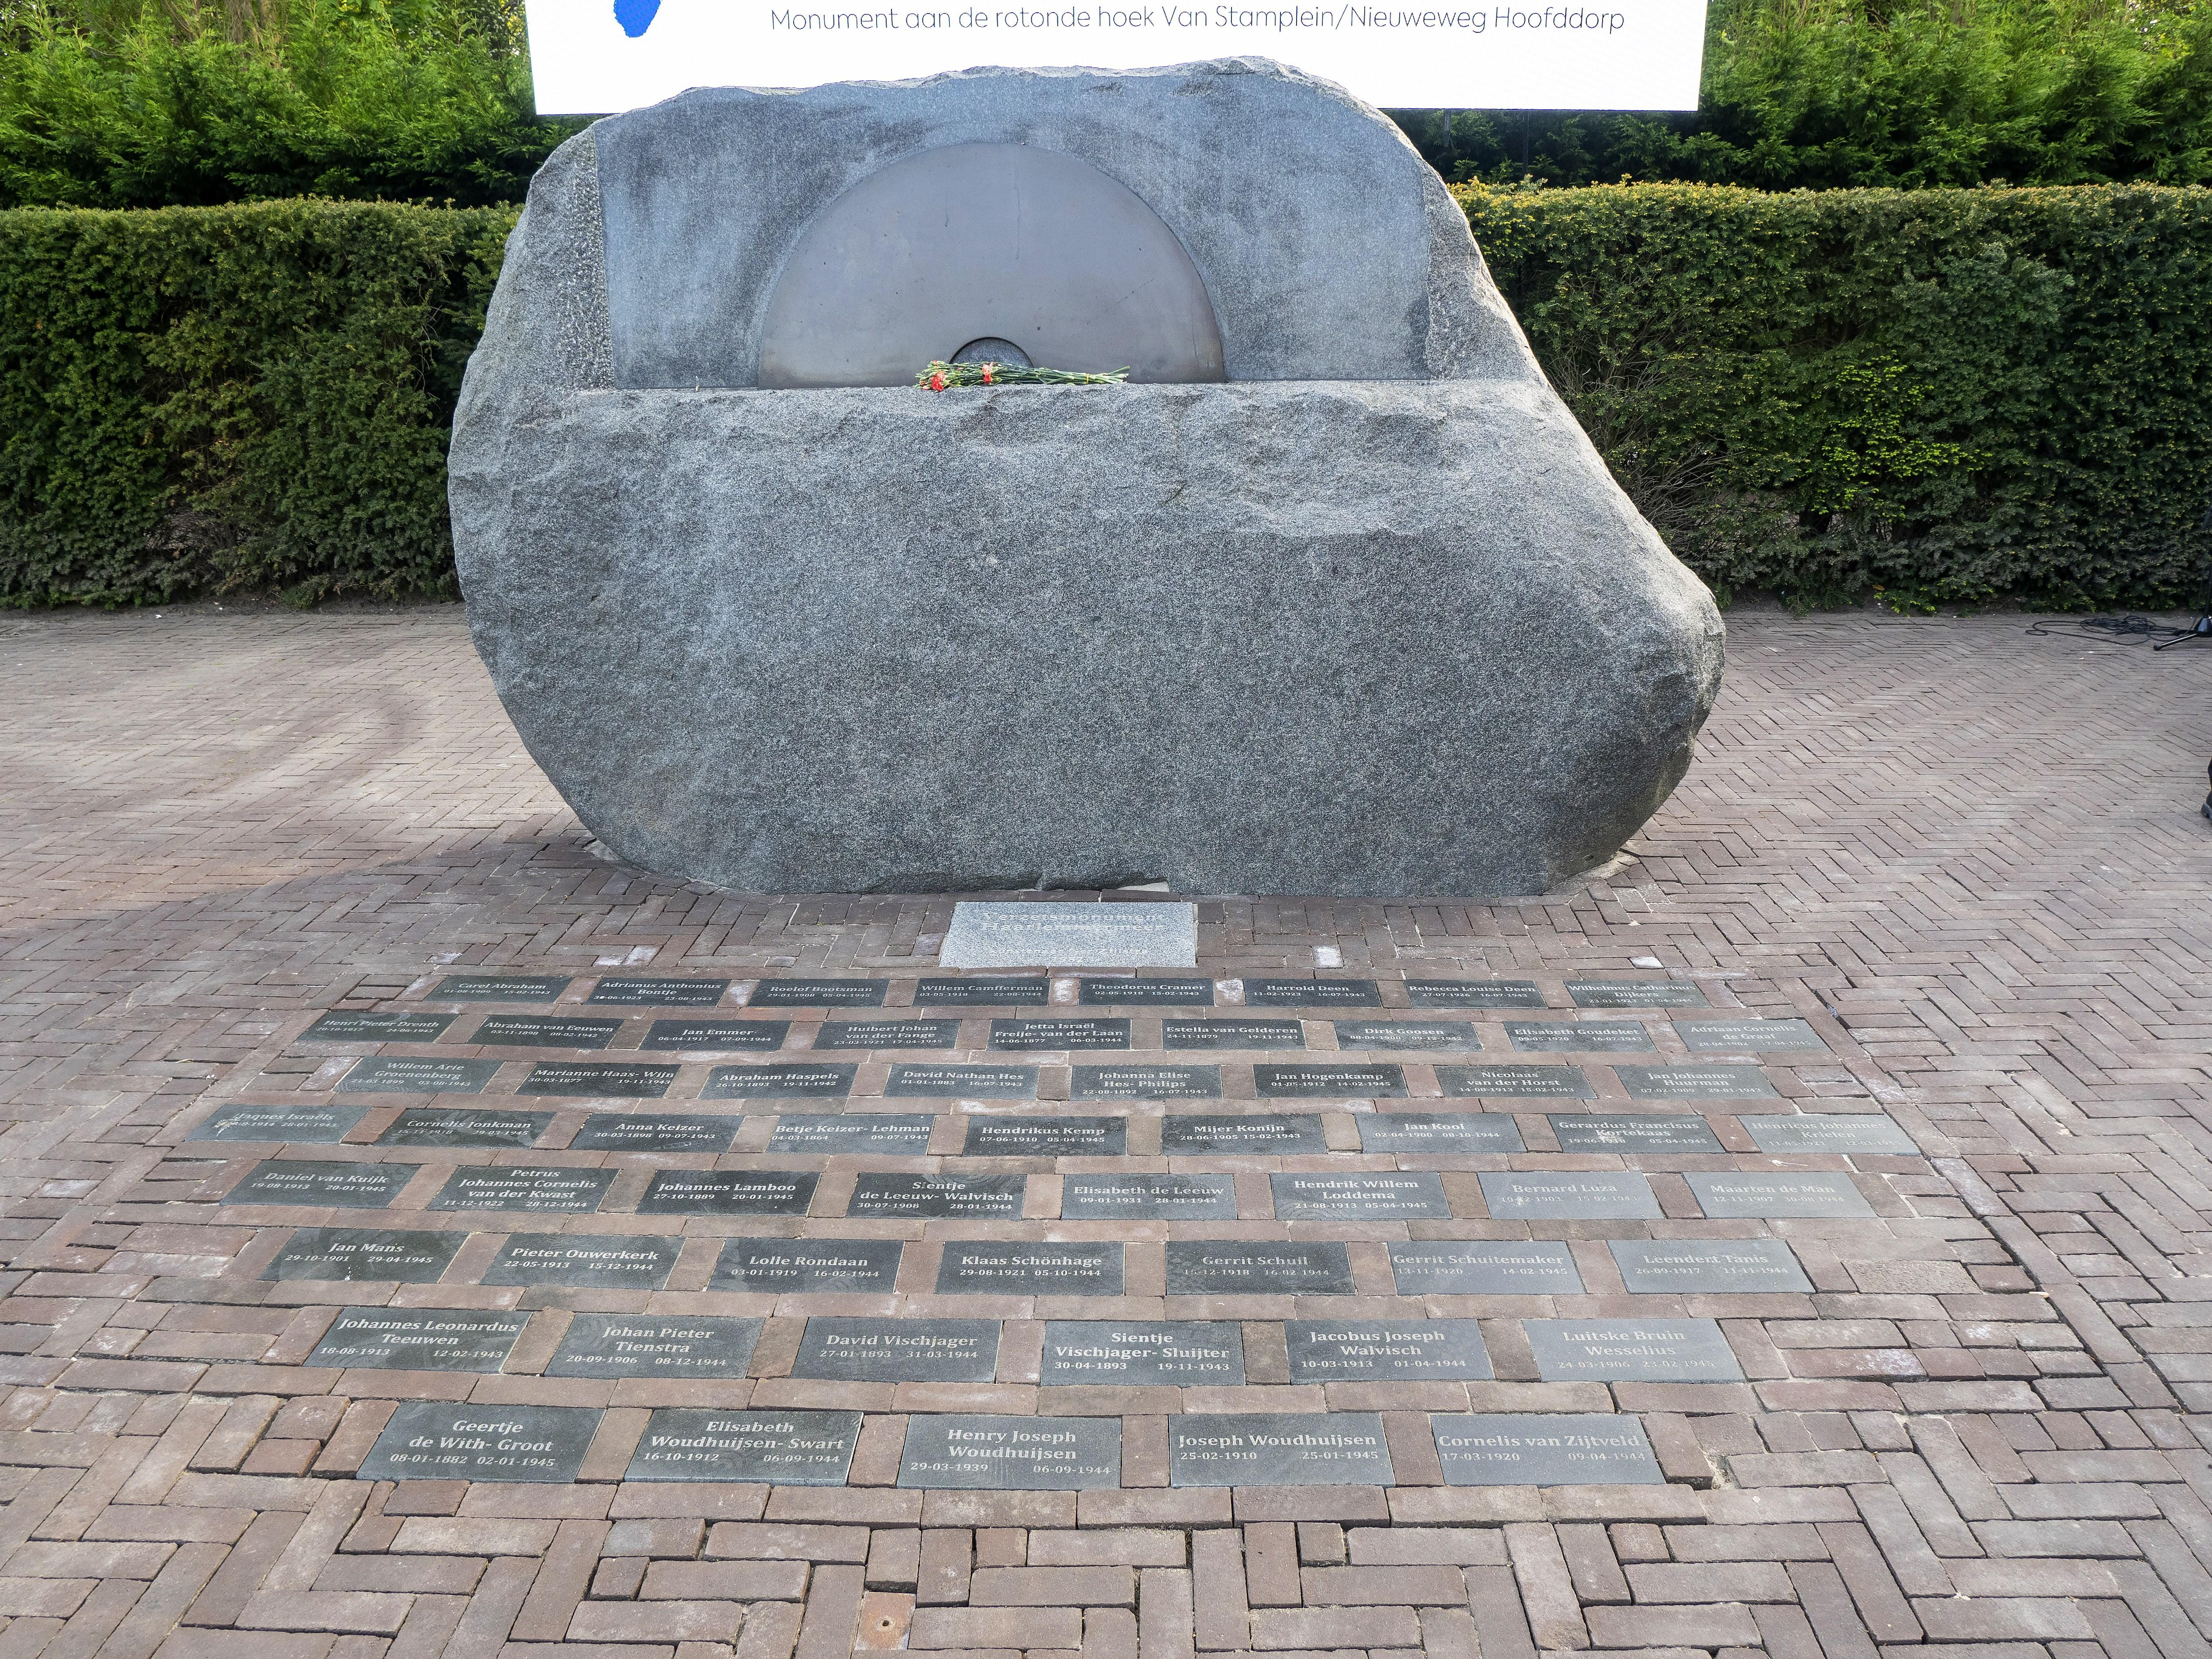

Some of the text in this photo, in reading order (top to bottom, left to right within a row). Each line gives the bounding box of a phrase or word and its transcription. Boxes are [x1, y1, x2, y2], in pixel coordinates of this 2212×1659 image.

[771, 4, 1624, 34] Monument aan de rotonde hoek Van Stamplein/Nieuweweg Hoofddorp
[982, 912, 1166, 921] Verzetsmonument
[980, 922, 1164, 931] Haarlemmermeer
[775, 1126, 813, 1134] Betje
[982, 1126, 1105, 1136] Hendrikus Kemp
[264, 1173, 316, 1181] Daniel
[346, 1175, 389, 1184] Kuijk
[657, 1183, 730, 1192] Johannes
[912, 1181, 966, 1191] Sientje
[944, 1192, 1013, 1201] Walvisch
[1322, 1191, 1396, 1200] Loddema
[327, 1243, 405, 1253] Jan Mans
[749, 1256, 868, 1266] Lolle Rondaan
[962, 1256, 1102, 1267] Klaas Schönhage
[1201, 1256, 1308, 1265] Gerrit Schuil
[1643, 1255, 1769, 1263] Leendert Tanis
[337, 1318, 519, 1332] Johannes Leonardus
[382, 1334, 459, 1345] Teeuwen
[1111, 1332, 1173, 1345] Sientje
[1562, 1330, 1686, 1341] Luitske Bruin
[826, 1335, 978, 1348] David Vischjager
[320, 1347, 503, 1358] 18-08-1913 12-02-1943
[819, 1349, 891, 1358] 27-01-1893
[1163, 1346, 1230, 1360] Sluijter
[1583, 1345, 1676, 1356] Wesselius
[453, 1420, 523, 1435] Geertje
[947, 1429, 1076, 1445] Henry Joseph
[1179, 1434, 1376, 1449] Joseph Woudhuijsen
[1439, 1435, 1641, 1449] Cornelis van Zijtveld
[409, 1436, 434, 1447] de
[498, 1439, 554, 1451] Groot
[948, 1446, 1077, 1461] Woudhuijsen
[1180, 1451, 1378, 1460] 25-02-1910 25-01-1945
[1442, 1452, 1645, 1461] 17-03-1920 09-04-1944
[390, 1453, 556, 1466] 08-01-1882 02-01-1945
[910, 1462, 1111, 1474] 29-03-1939 06-09-1944
